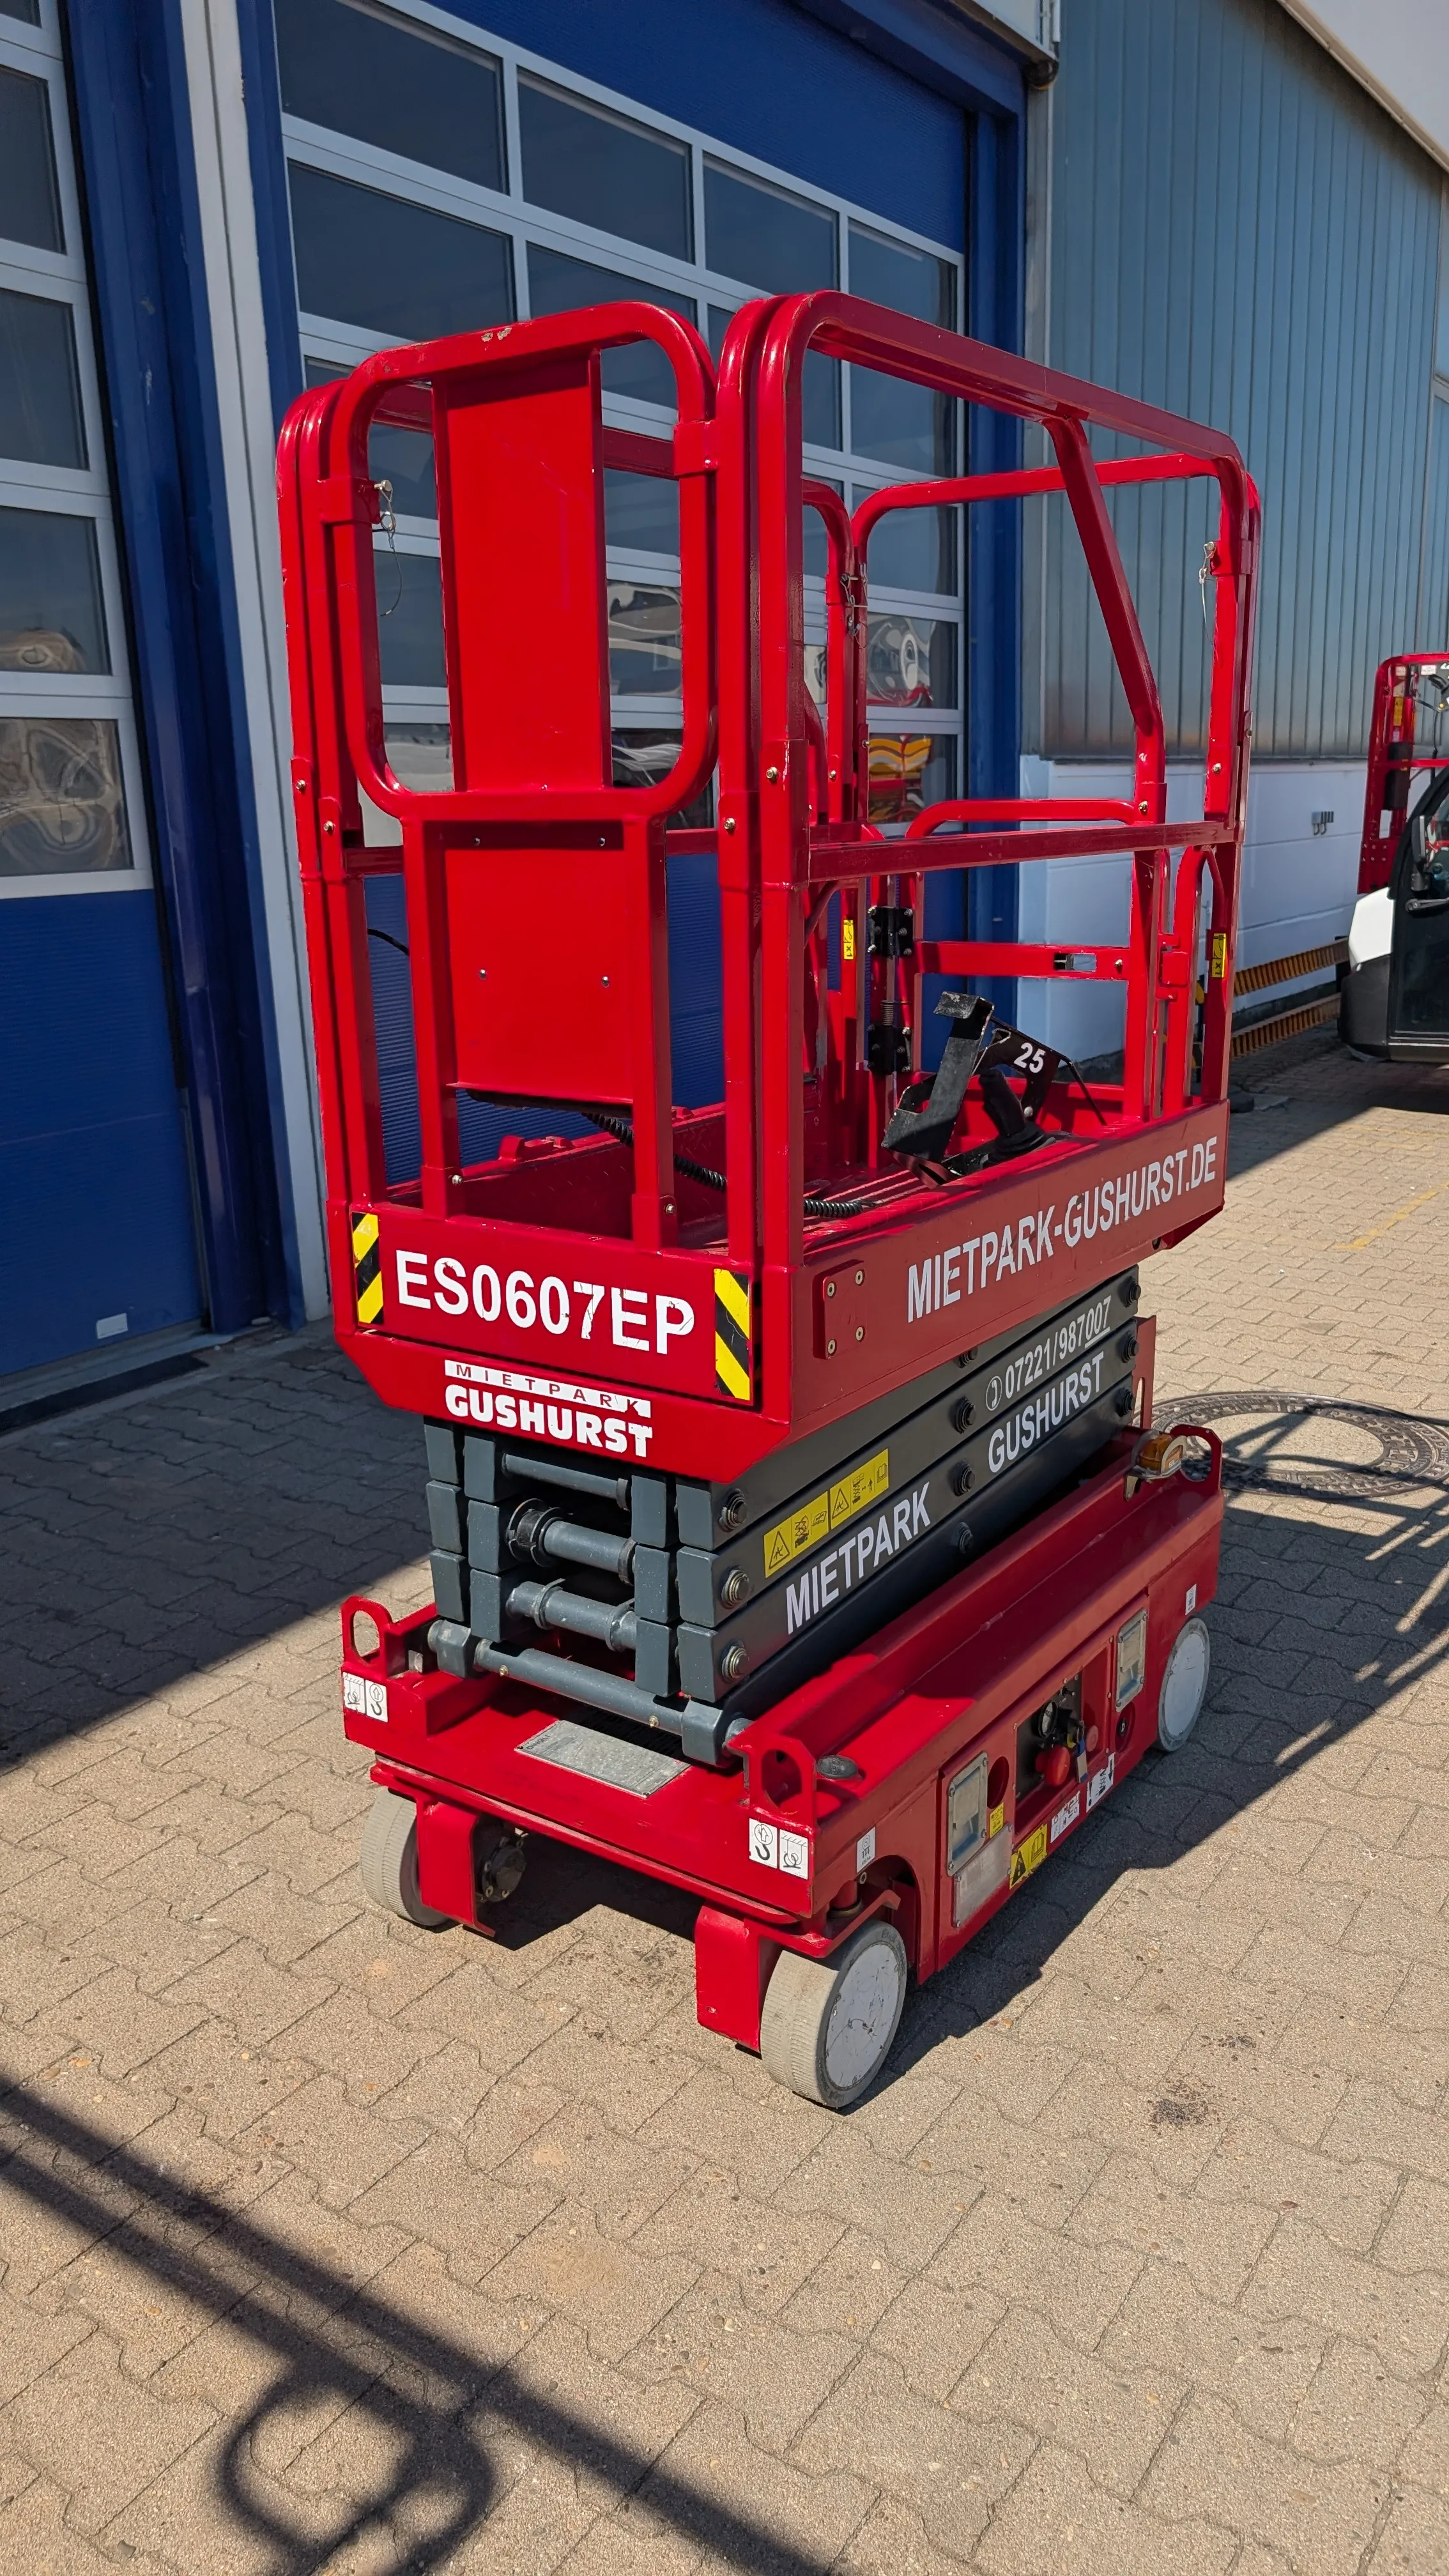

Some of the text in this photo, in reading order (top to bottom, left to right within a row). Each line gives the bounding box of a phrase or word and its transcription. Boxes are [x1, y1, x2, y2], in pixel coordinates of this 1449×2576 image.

[1014, 1042, 1045, 1073] 25
[907, 1136, 1218, 1323] MIETPARK-GUSHURST.DE
[395, 1250, 694, 1354] ES0607EP
[1005, 1294, 1112, 1400] 07221/987007
[445, 1384, 653, 1458] GUSHURST
[456, 1363, 640, 1414] MIETPARK
[786, 1351, 1105, 1636] MIETPARK GUSHURST
